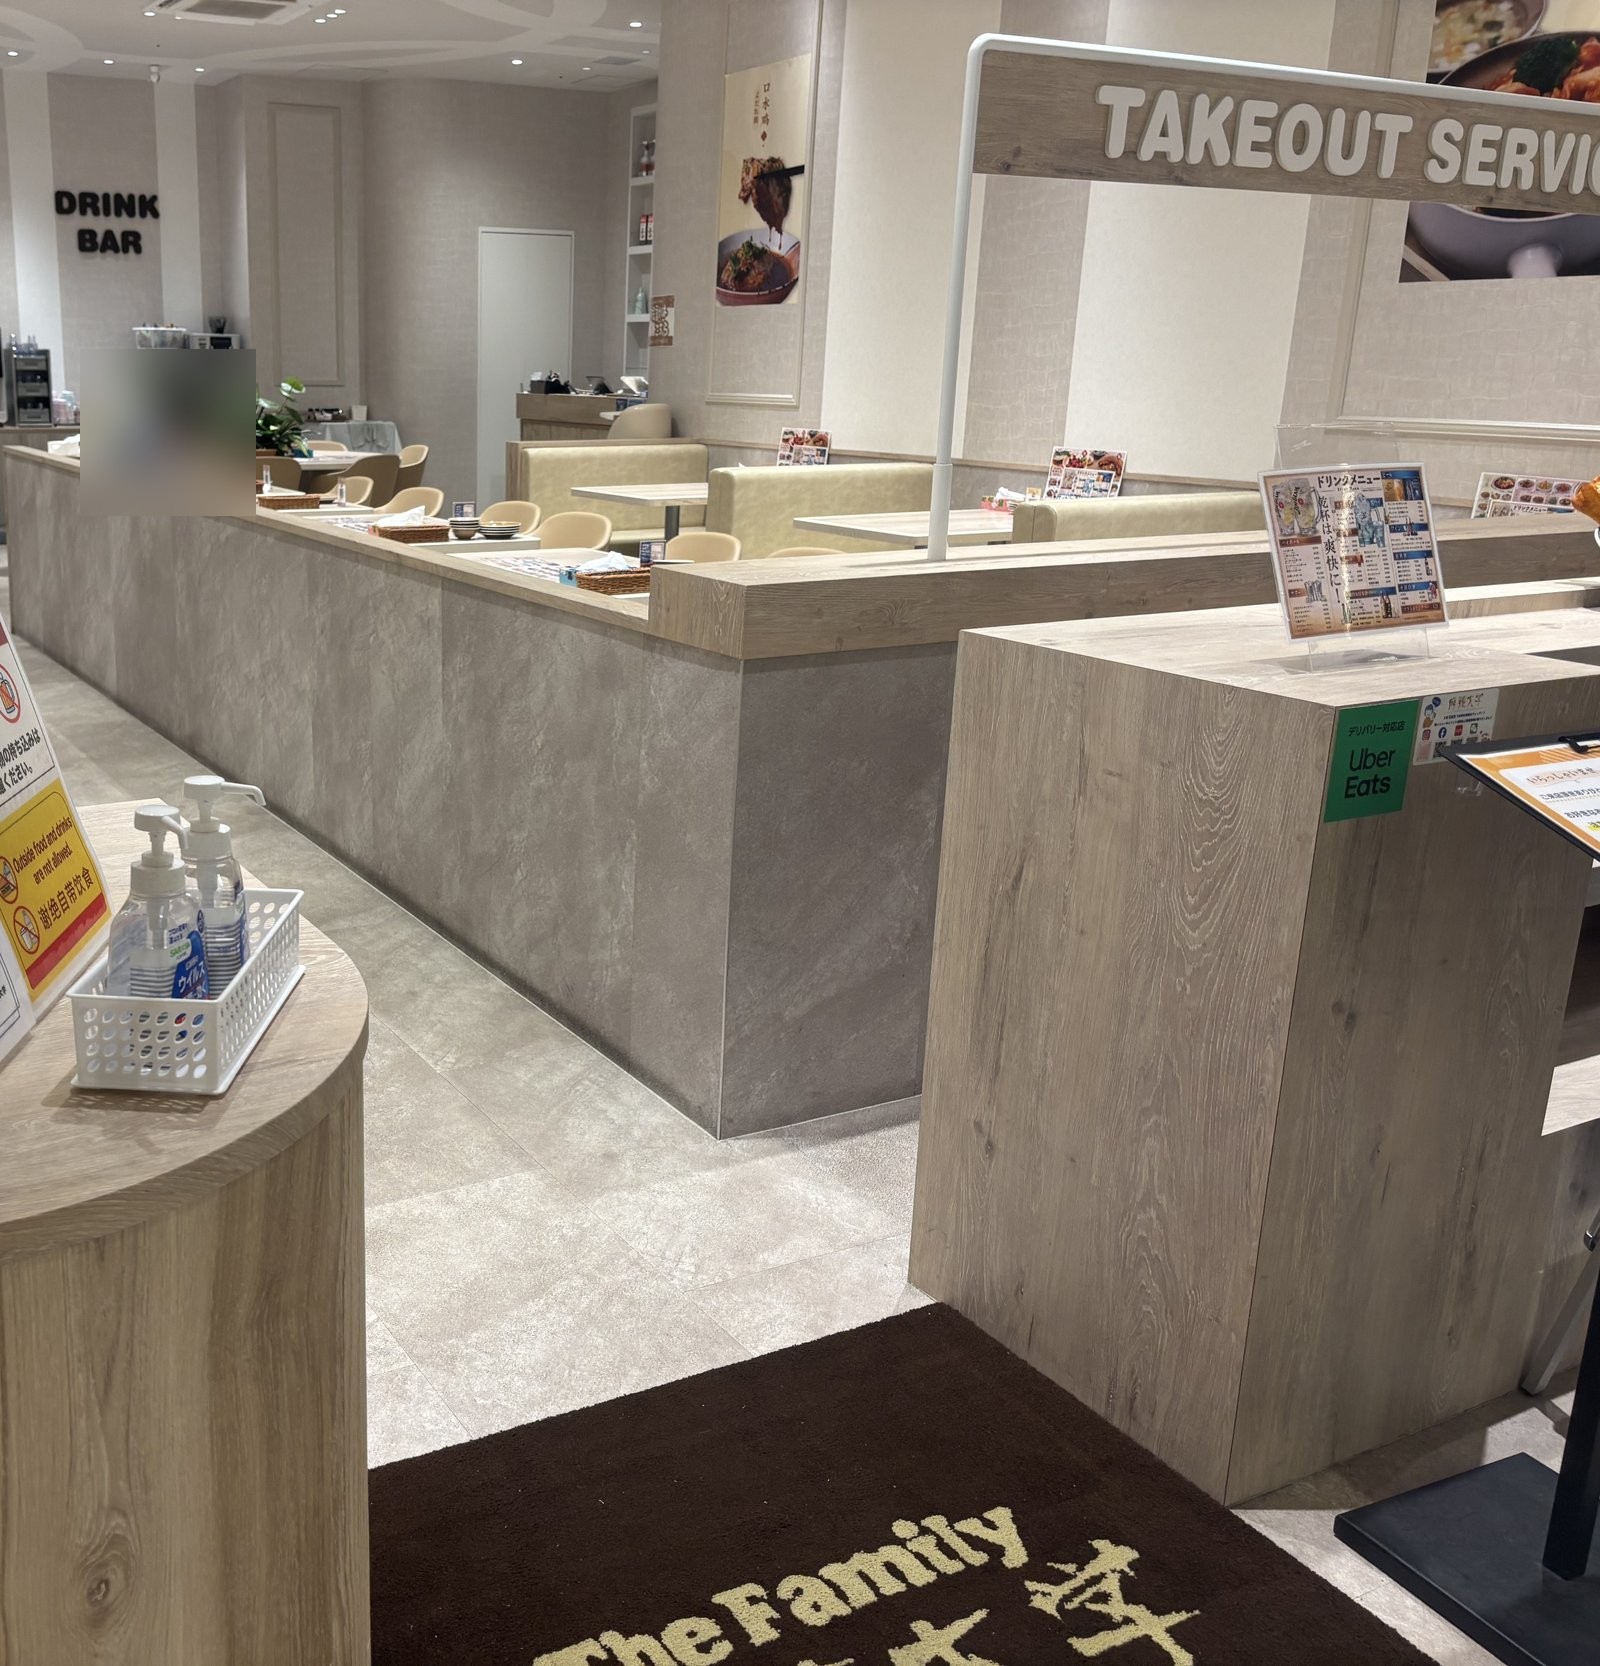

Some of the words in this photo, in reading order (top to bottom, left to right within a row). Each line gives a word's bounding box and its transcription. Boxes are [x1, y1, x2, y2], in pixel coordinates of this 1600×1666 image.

[1095, 85, 1414, 180] TAKEOUT
[54, 189, 160, 220] DRINK
[77, 228, 142, 255] BAR
[1317, 475, 1381, 489] ドリンクメニュー
[1348, 720, 1407, 737] デリバリー対応店
[1349, 747, 1396, 772] Uber
[1344, 773, 1392, 799] Eats
[13, 847, 35, 874] Outside
[34, 834, 47, 856] food
[46, 826, 57, 846] and
[55, 816, 73, 838] drinks
[33, 869, 44, 885] are
[43, 861, 53, 877] not
[51, 842, 73, 869] allowed.
[38, 866, 94, 930] 谢绝自带饮食
[178, 960, 205, 993] ウイルス
[532, 1615, 733, 1666] The
[712, 1505, 1029, 1648] Family
